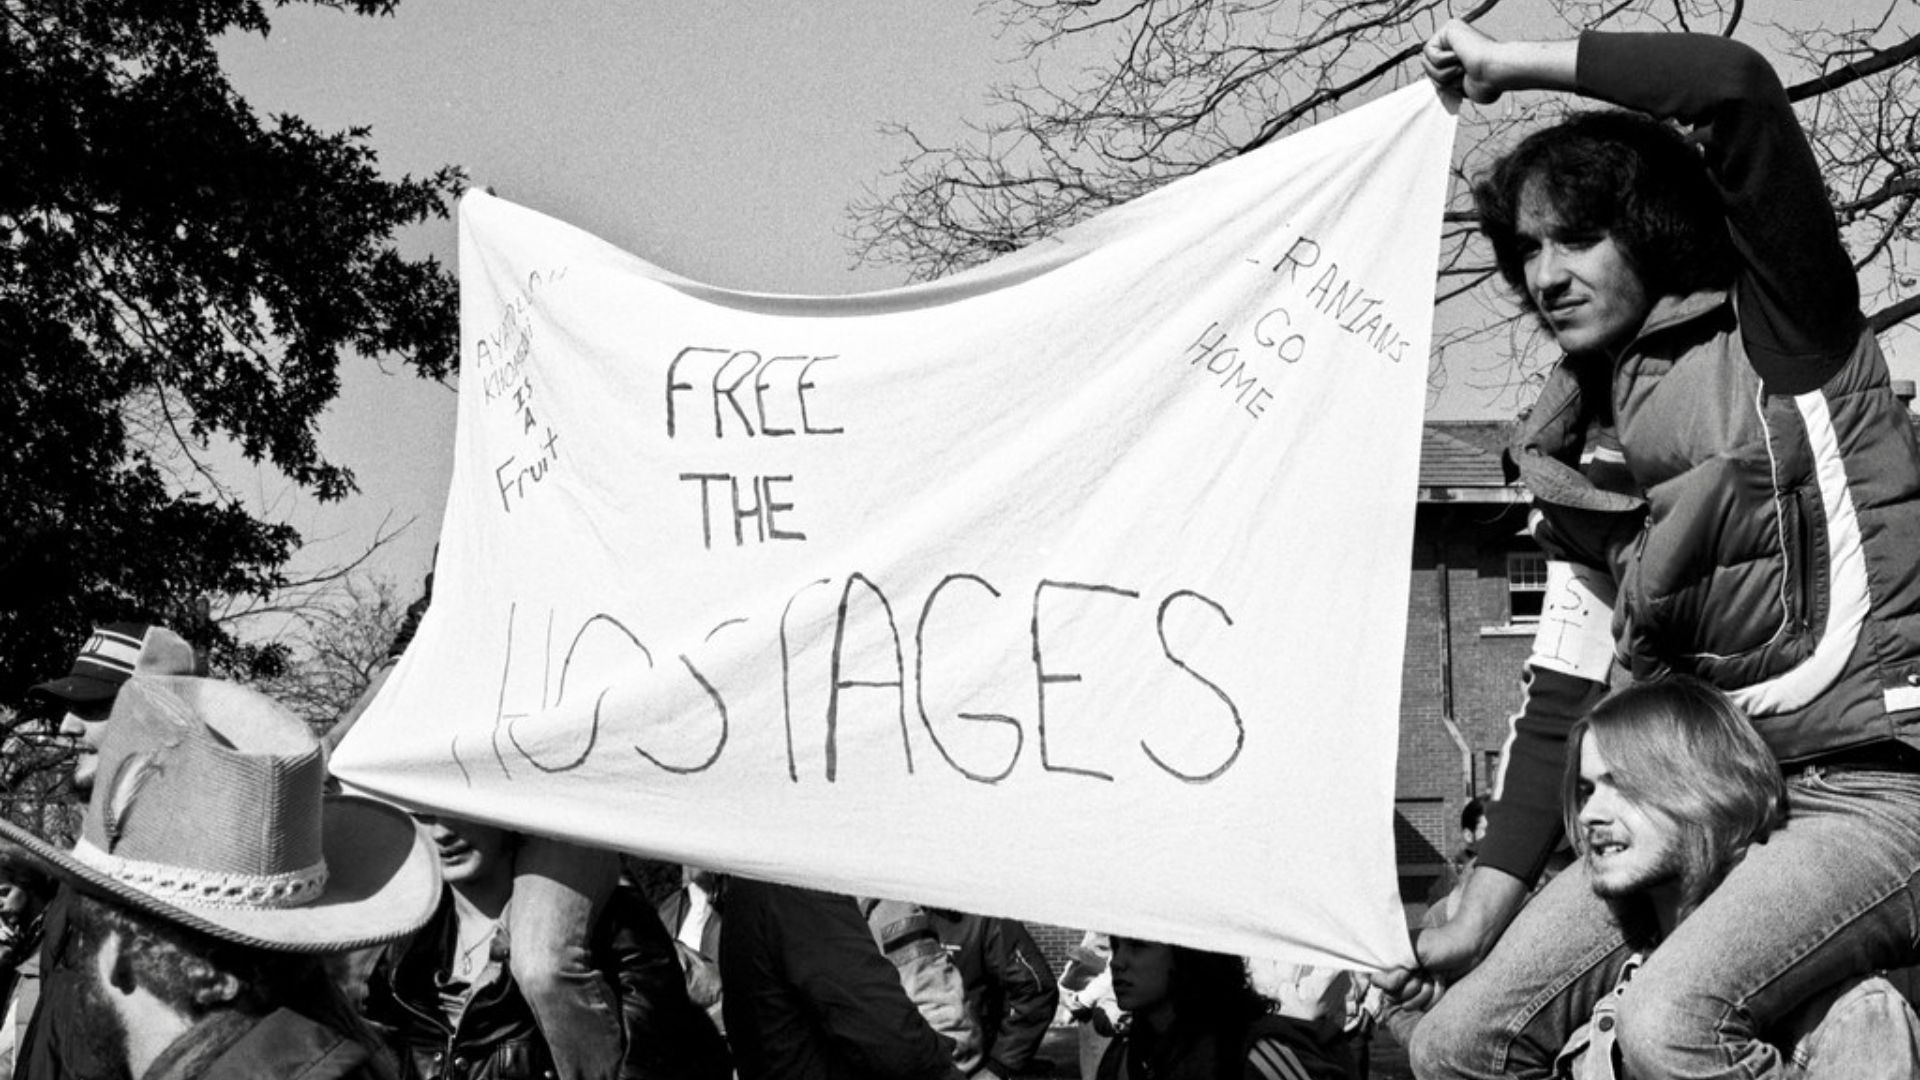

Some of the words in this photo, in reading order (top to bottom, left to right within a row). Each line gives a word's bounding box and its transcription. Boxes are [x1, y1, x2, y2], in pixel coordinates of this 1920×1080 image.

[1246, 222, 1411, 364] RANIANS
[1254, 307, 1306, 363] GO
[512, 376, 533, 415] IS
[666, 346, 845, 439] FREE
[1185, 321, 1274, 420] HOME
[524, 405, 537, 436] A
[496, 426, 558, 514] Fruit
[679, 472, 807, 550] THE
[452, 572, 1244, 787] HOSTAGES
